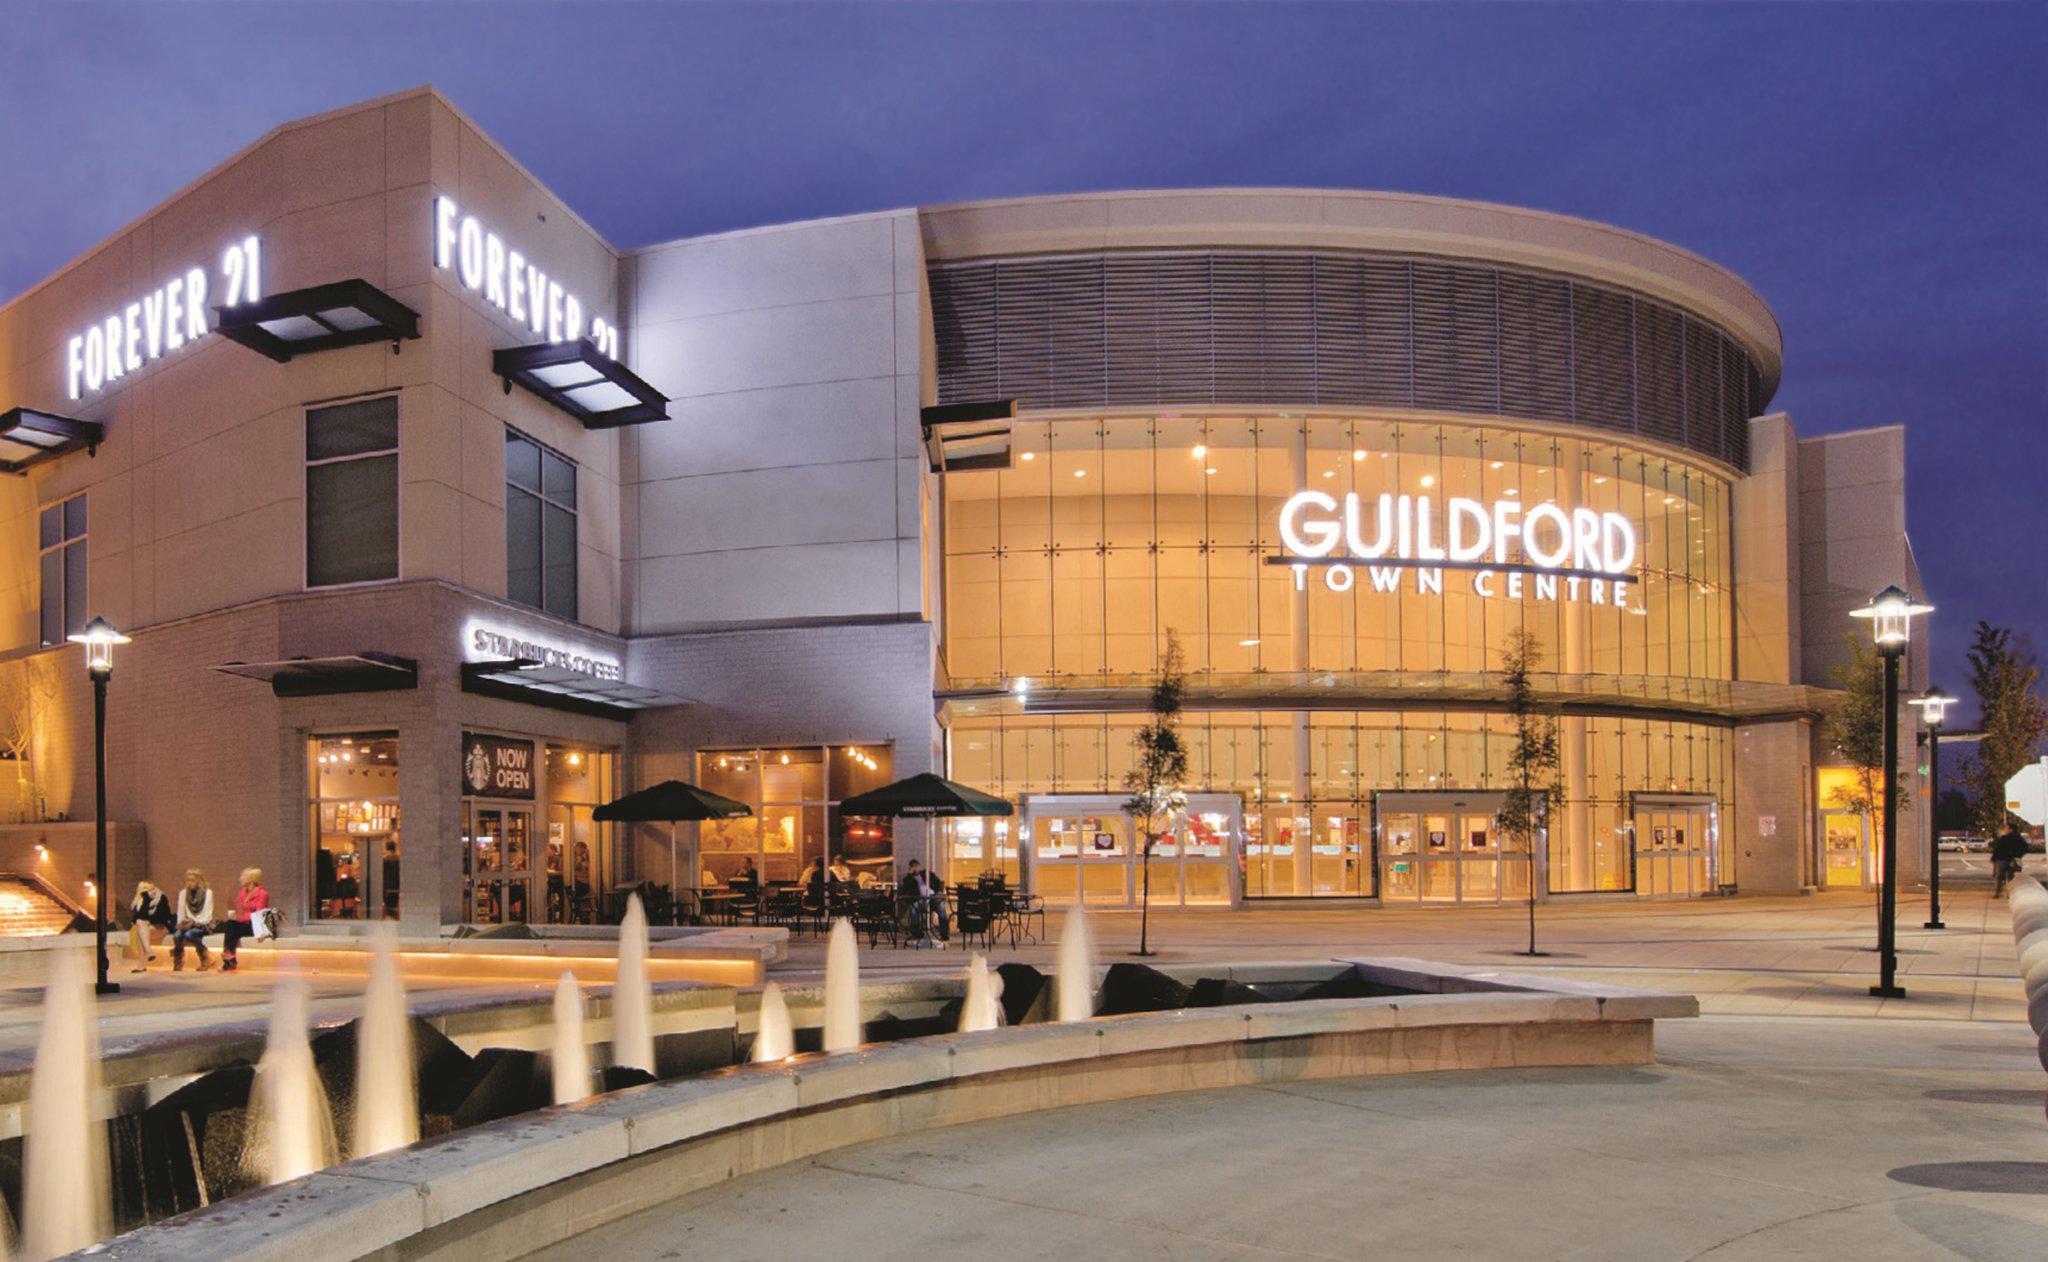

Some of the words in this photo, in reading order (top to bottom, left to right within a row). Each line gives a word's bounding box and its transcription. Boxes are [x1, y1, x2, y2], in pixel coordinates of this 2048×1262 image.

[434, 195, 582, 342] FOREVER
[68, 267, 209, 401] FOREVER
[223, 235, 260, 308] 21
[1278, 490, 1636, 574] GUILDFORD
[1290, 562, 1443, 595] TOWN
[1474, 569, 1628, 607] CENTRE
[474, 628, 573, 670] STARBUCKS
[496, 768, 531, 790] OPEN
[497, 748, 528, 769] NOW
